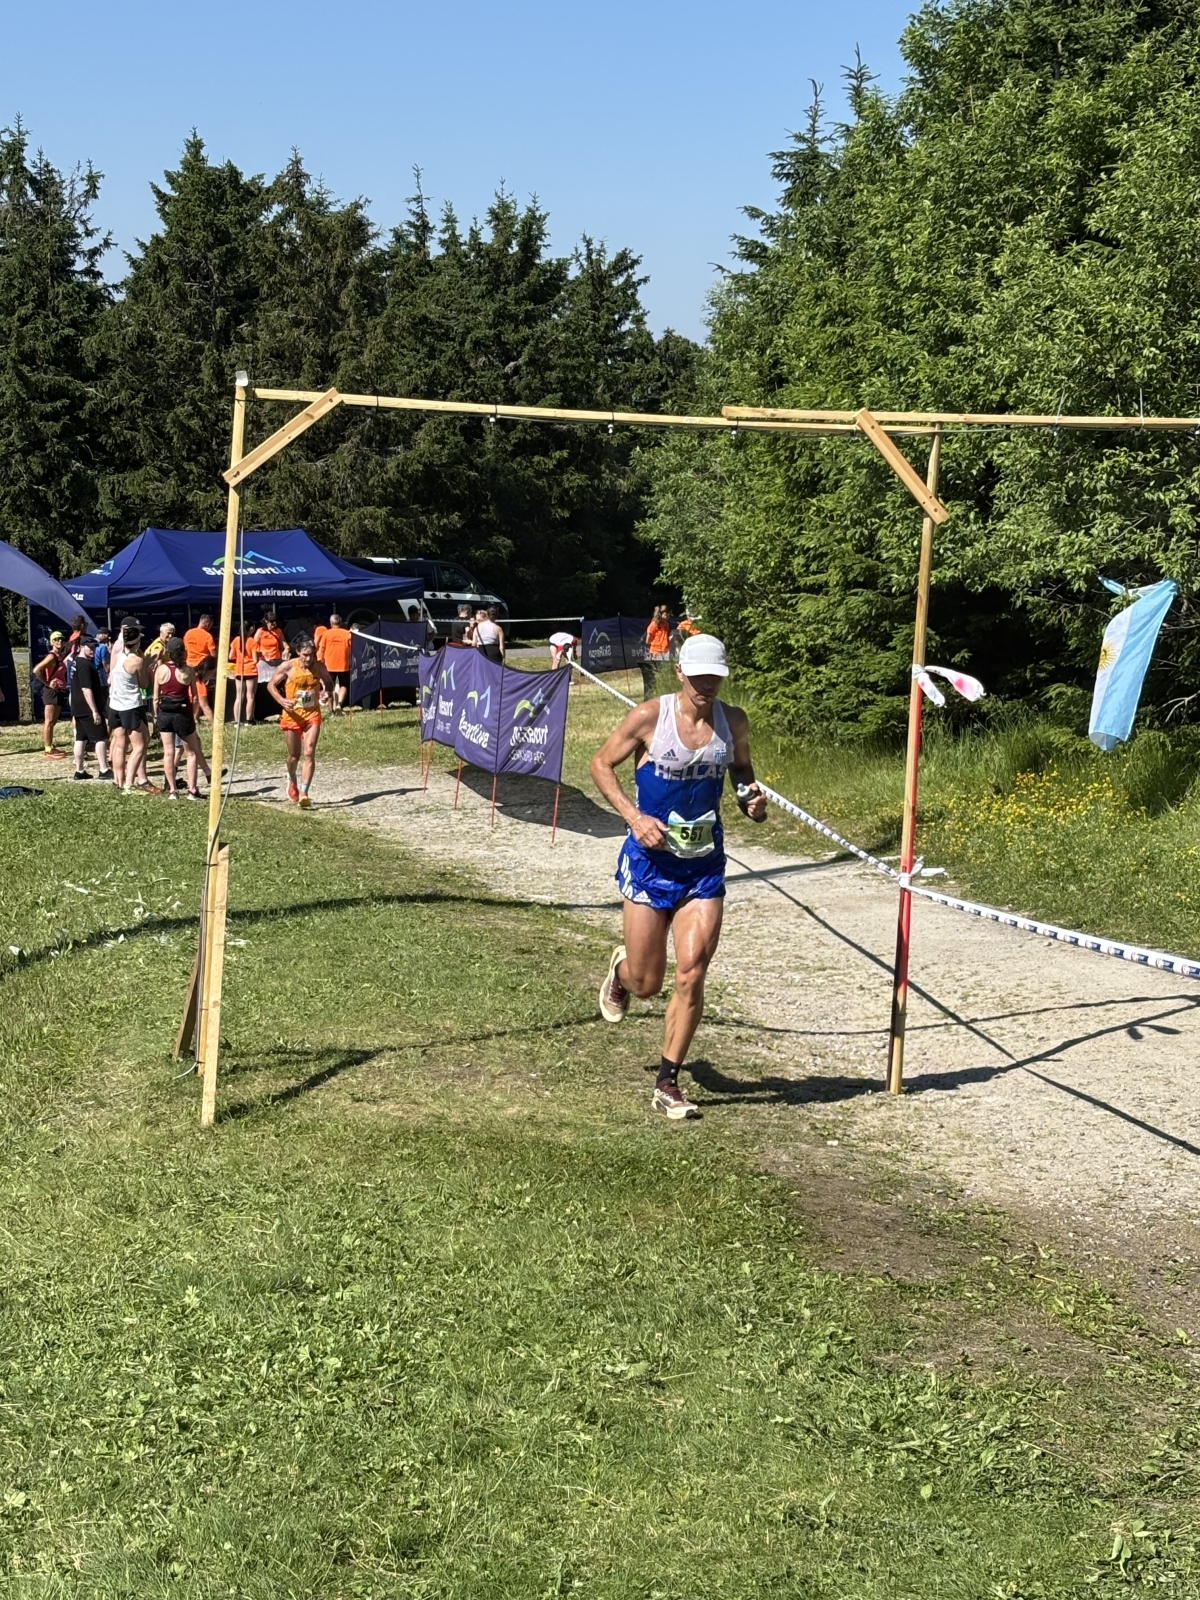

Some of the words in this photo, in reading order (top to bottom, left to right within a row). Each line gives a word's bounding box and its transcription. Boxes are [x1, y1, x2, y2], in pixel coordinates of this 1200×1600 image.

[202, 566, 307, 575] SkesortLive
[239, 588, 308, 597] www.skiresort.cz
[680, 826, 704, 842] 557
